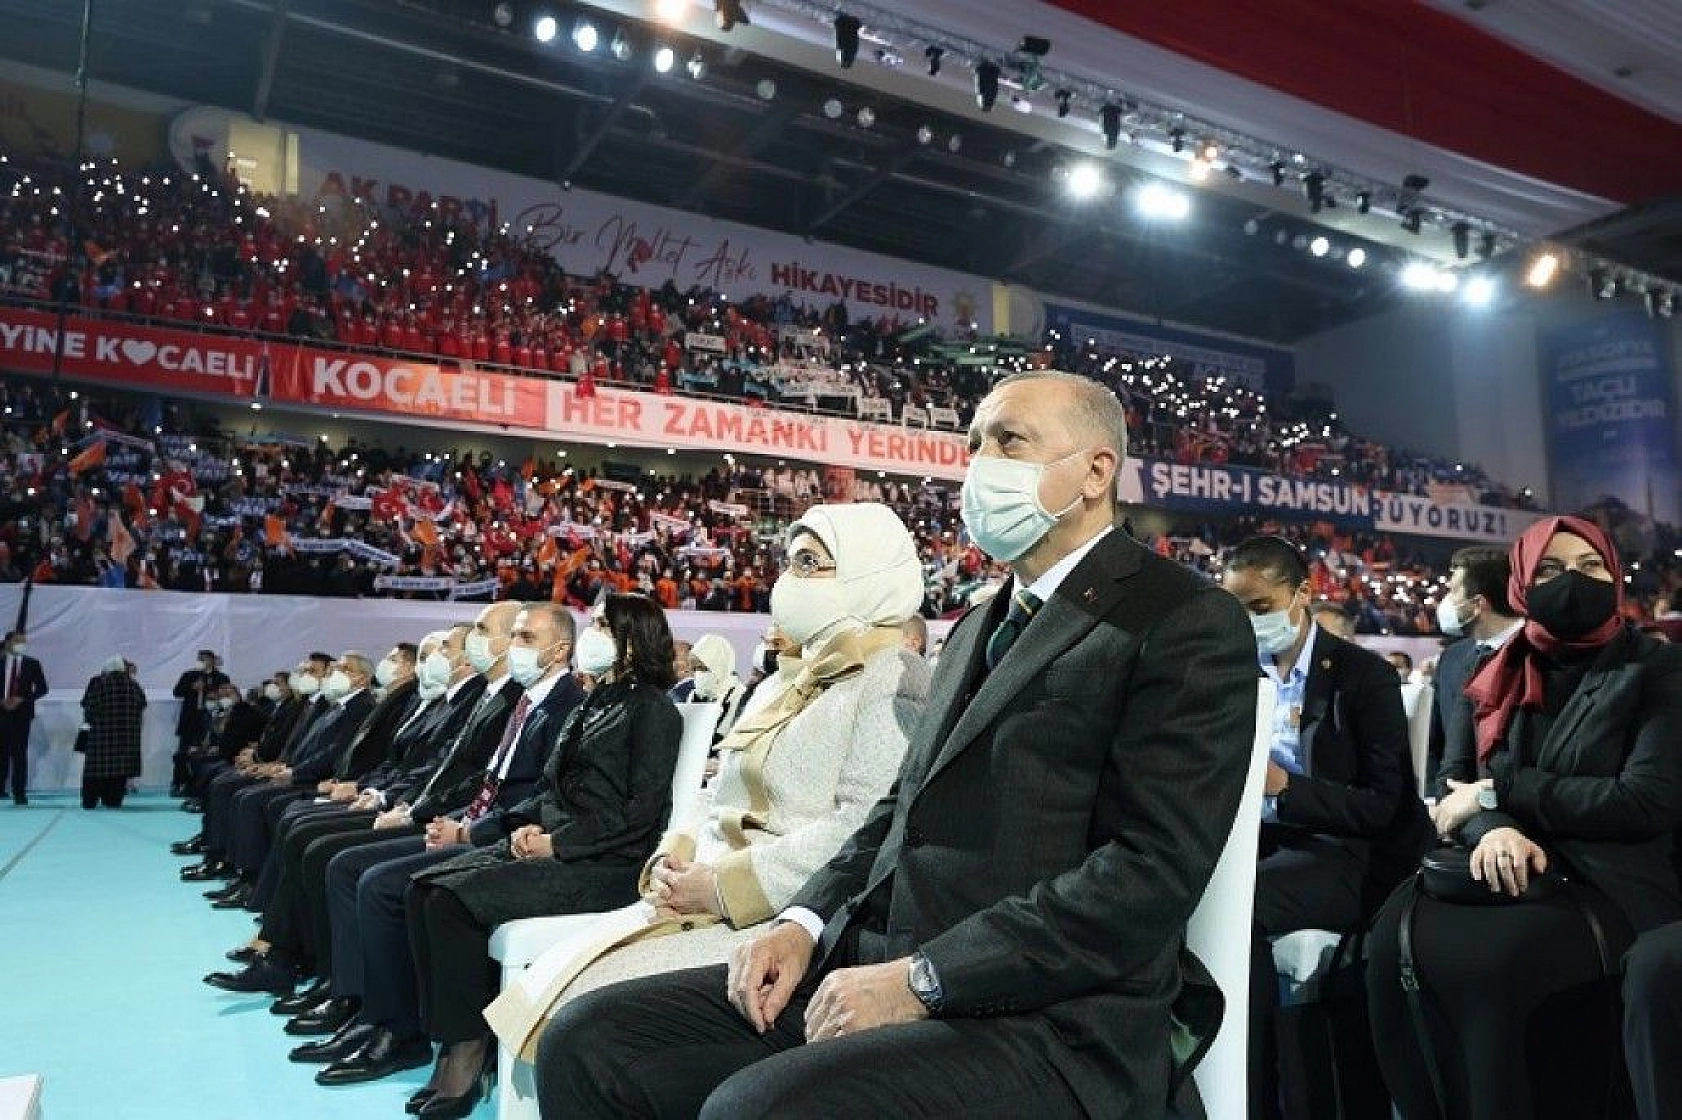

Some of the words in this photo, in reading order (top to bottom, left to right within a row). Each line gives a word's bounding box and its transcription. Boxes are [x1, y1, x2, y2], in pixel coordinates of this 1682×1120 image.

[770, 261, 939, 317] HİKAYESİDİR
[563, 391, 642, 431] HER
[1257, 475, 1370, 516] SAMSUN
